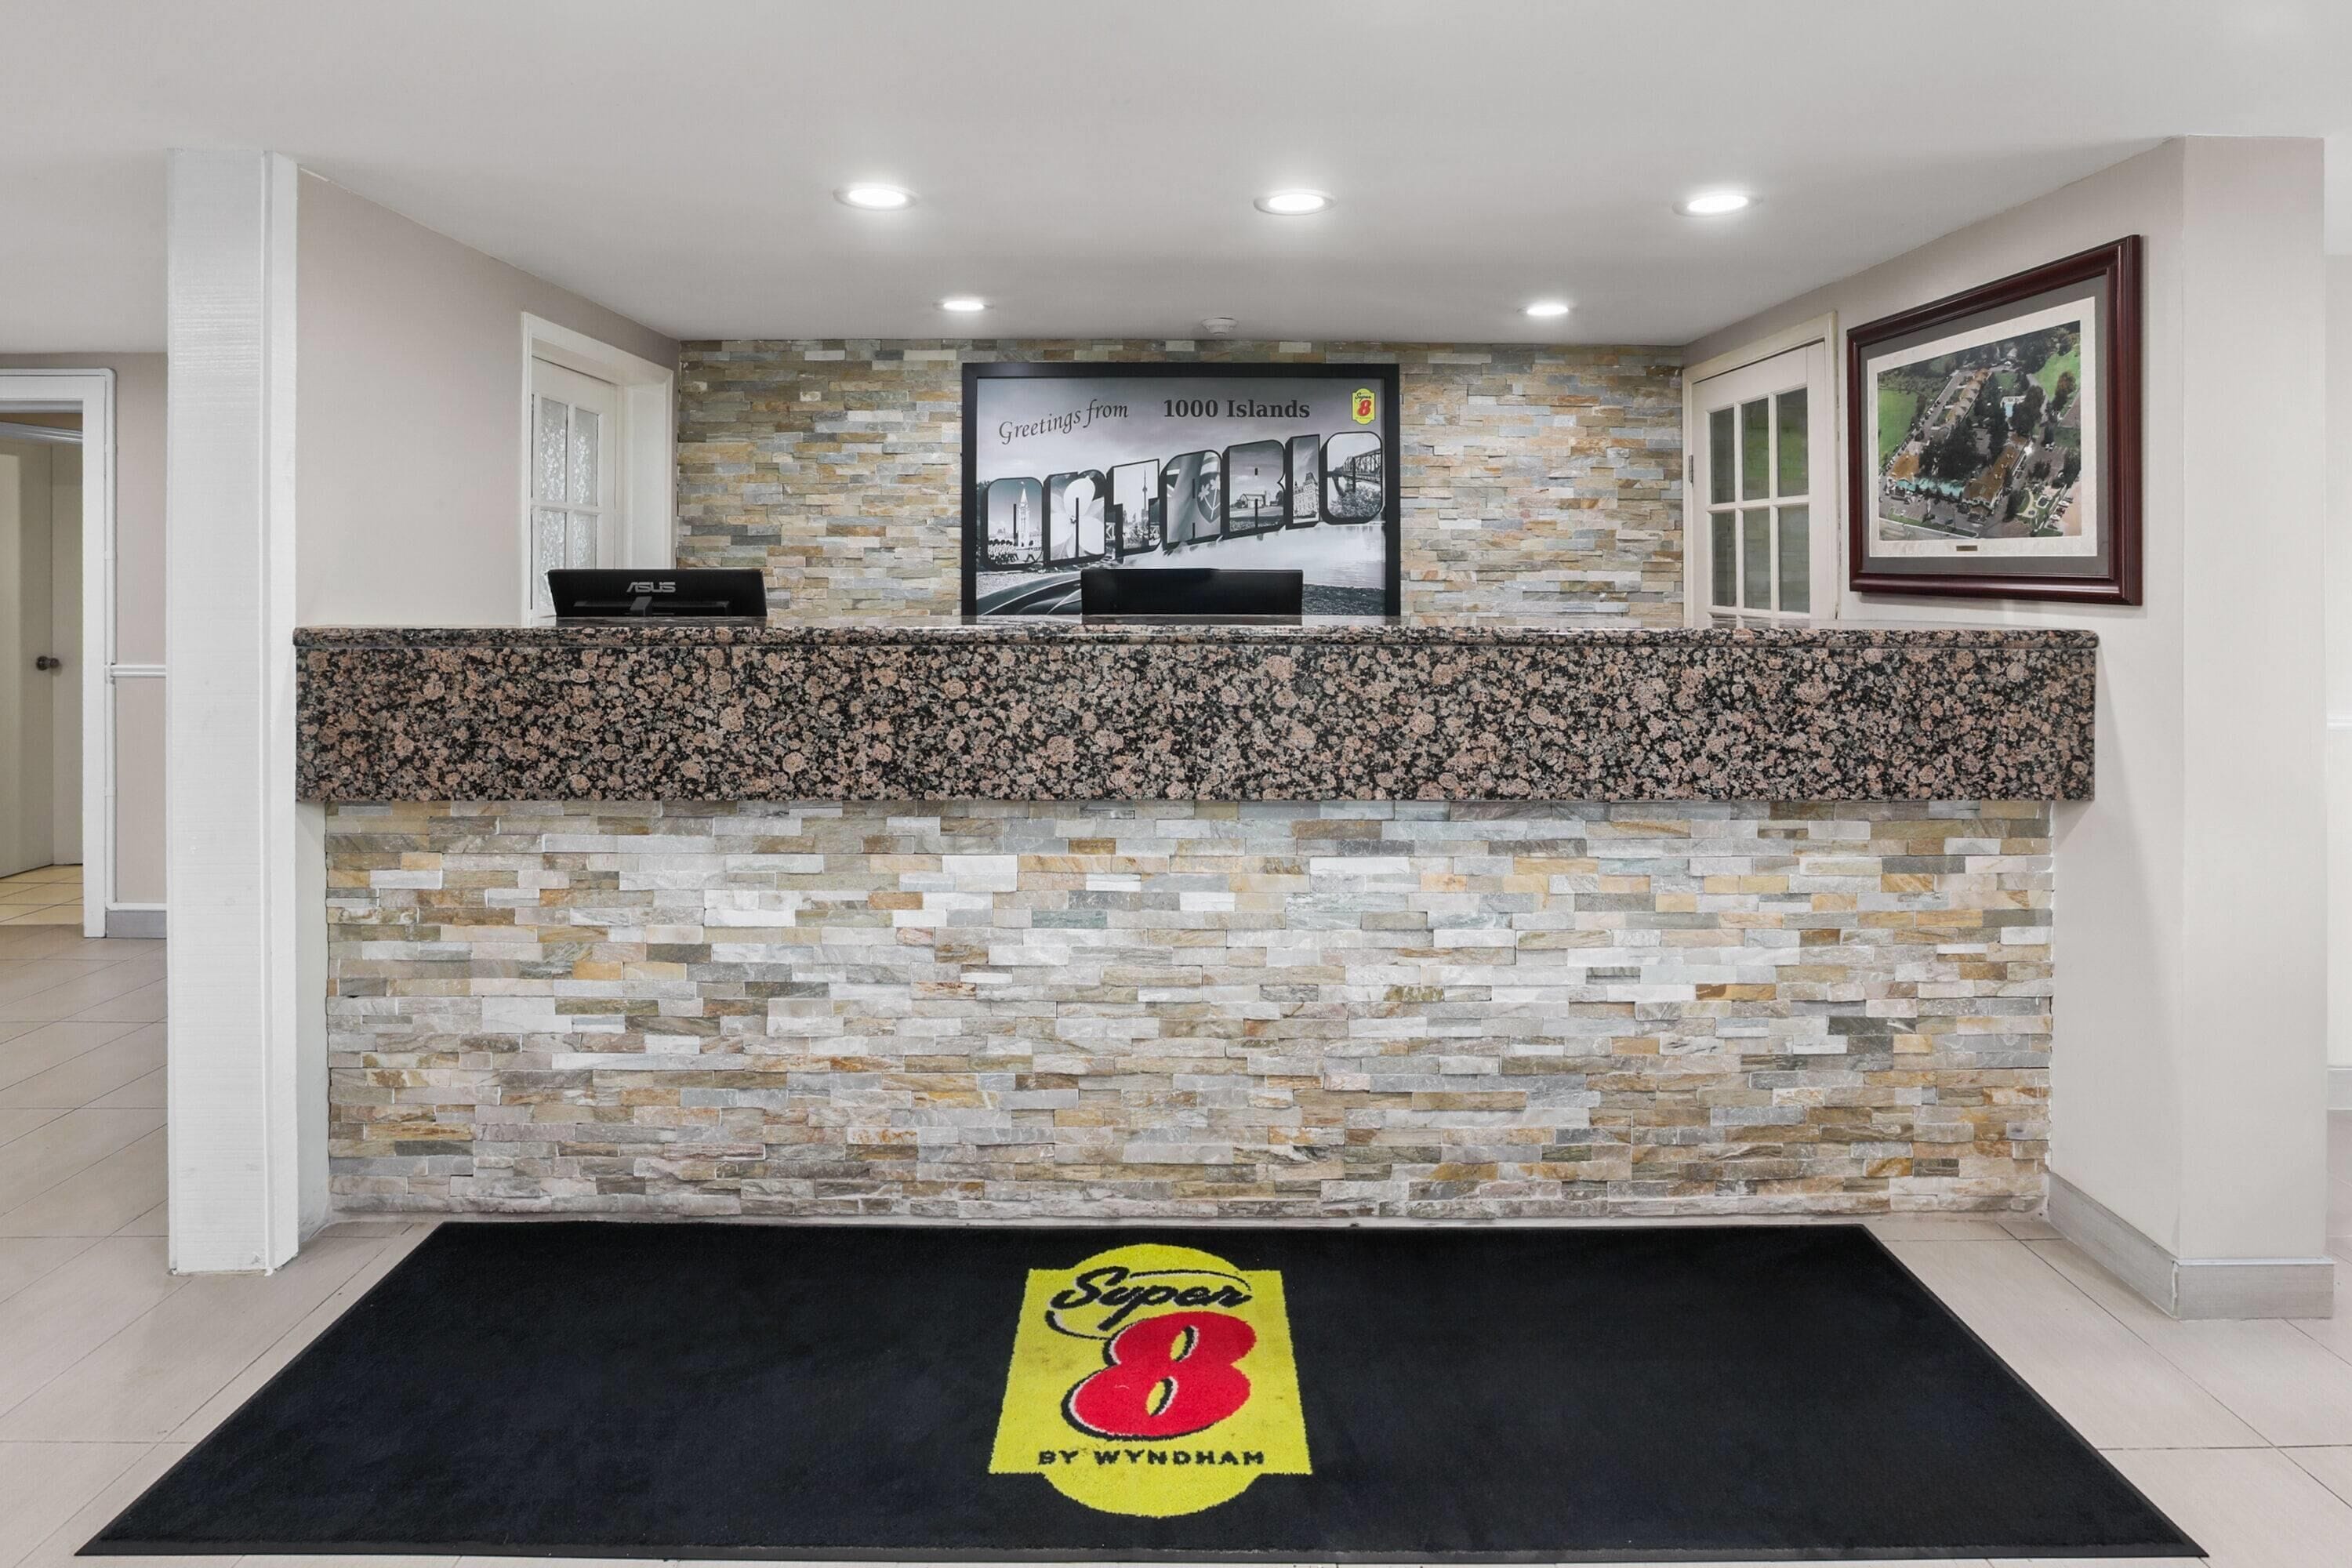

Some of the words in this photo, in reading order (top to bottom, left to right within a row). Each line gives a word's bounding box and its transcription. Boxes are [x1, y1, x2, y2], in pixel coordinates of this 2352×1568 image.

[999, 408, 1081, 445] Greetings
[1082, 398, 1129, 428] from
[1163, 399, 1218, 418] 1000
[1226, 398, 1310, 418] Islands
[1357, 399, 1372, 416] 8
[985, 431, 1384, 570] ONTARIO
[626, 582, 676, 593] ASUS
[1047, 1266, 1252, 1331] Super
[1061, 1311, 1257, 1441] 8
[1038, 1450, 1079, 1465] BY
[1094, 1449, 1265, 1466] WYNDHAM
